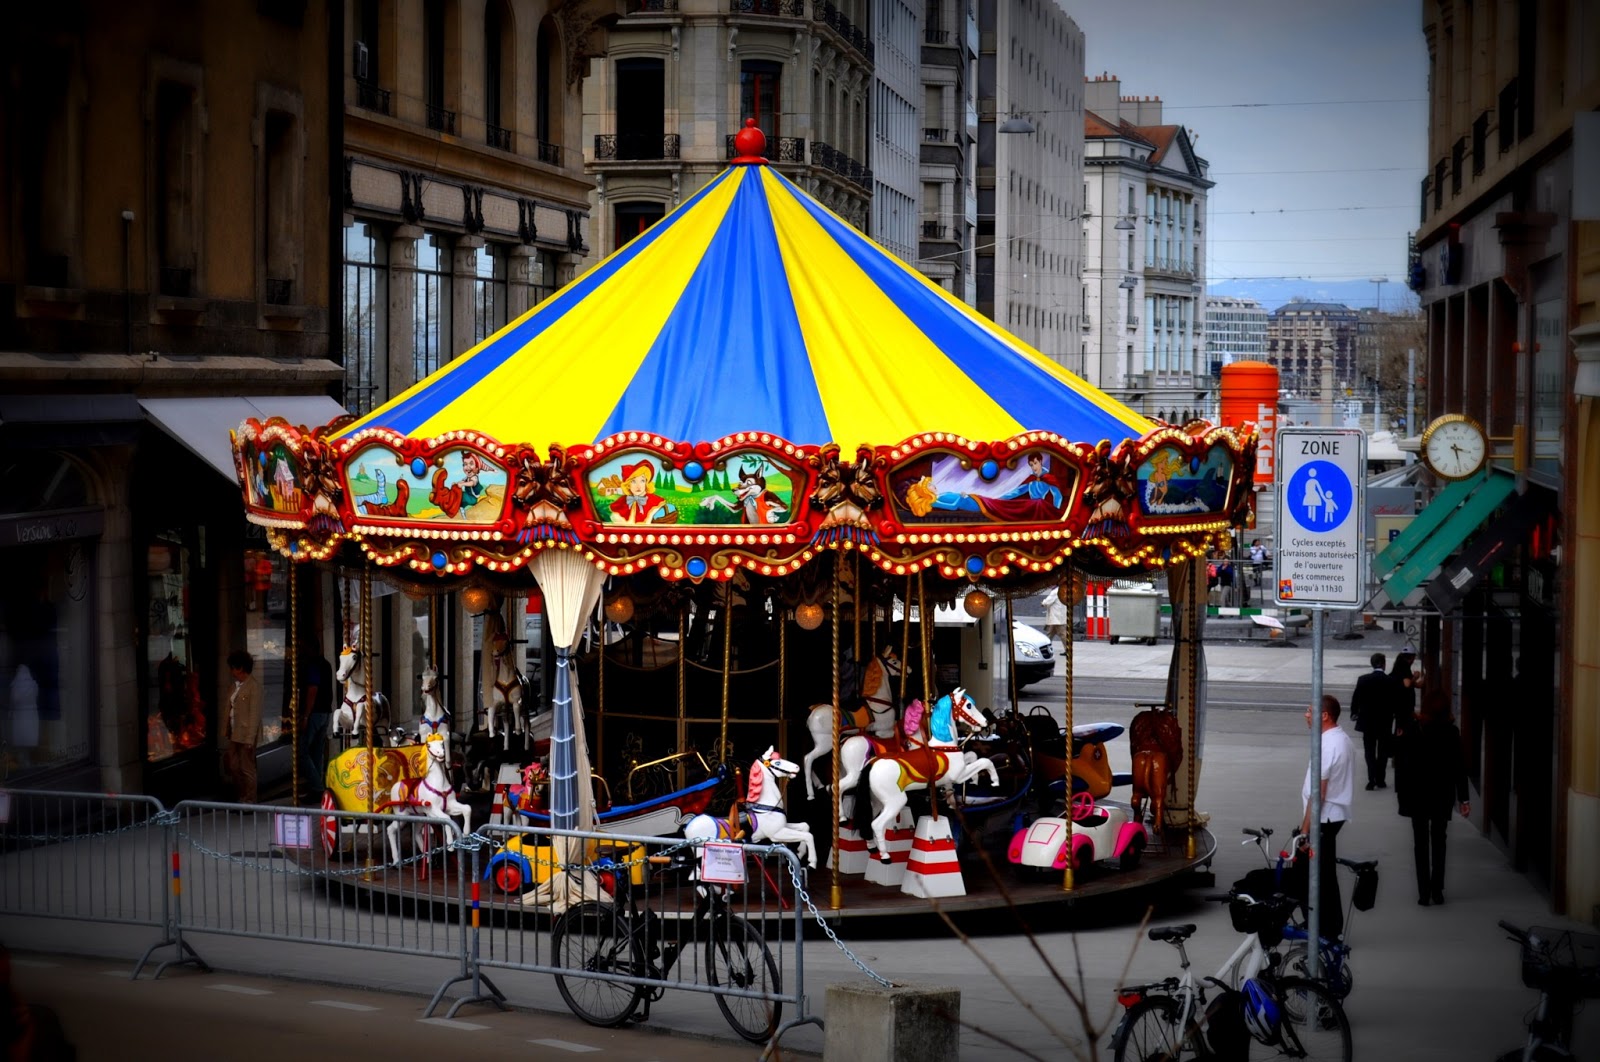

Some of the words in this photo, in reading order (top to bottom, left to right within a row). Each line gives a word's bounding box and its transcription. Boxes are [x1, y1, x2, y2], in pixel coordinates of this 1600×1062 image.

[1257, 403, 1273, 475] FIXIT
[1301, 440, 1340, 455] ZONE
[16, 520, 52, 543] Version
[1291, 538, 1314, 547] Cycles
[1315, 539, 1346, 549] exceptés
[1282, 549, 1317, 558] Livraisons
[1319, 551, 1355, 559] autorisées
[1294, 561, 1303, 569] de
[1304, 561, 1343, 570] l'ouverture
[1292, 572, 1304, 580] des
[1306, 574, 1345, 582] commerces
[1293, 584, 1319, 593] jusqu'à
[1321, 584, 1343, 593] 11h30
